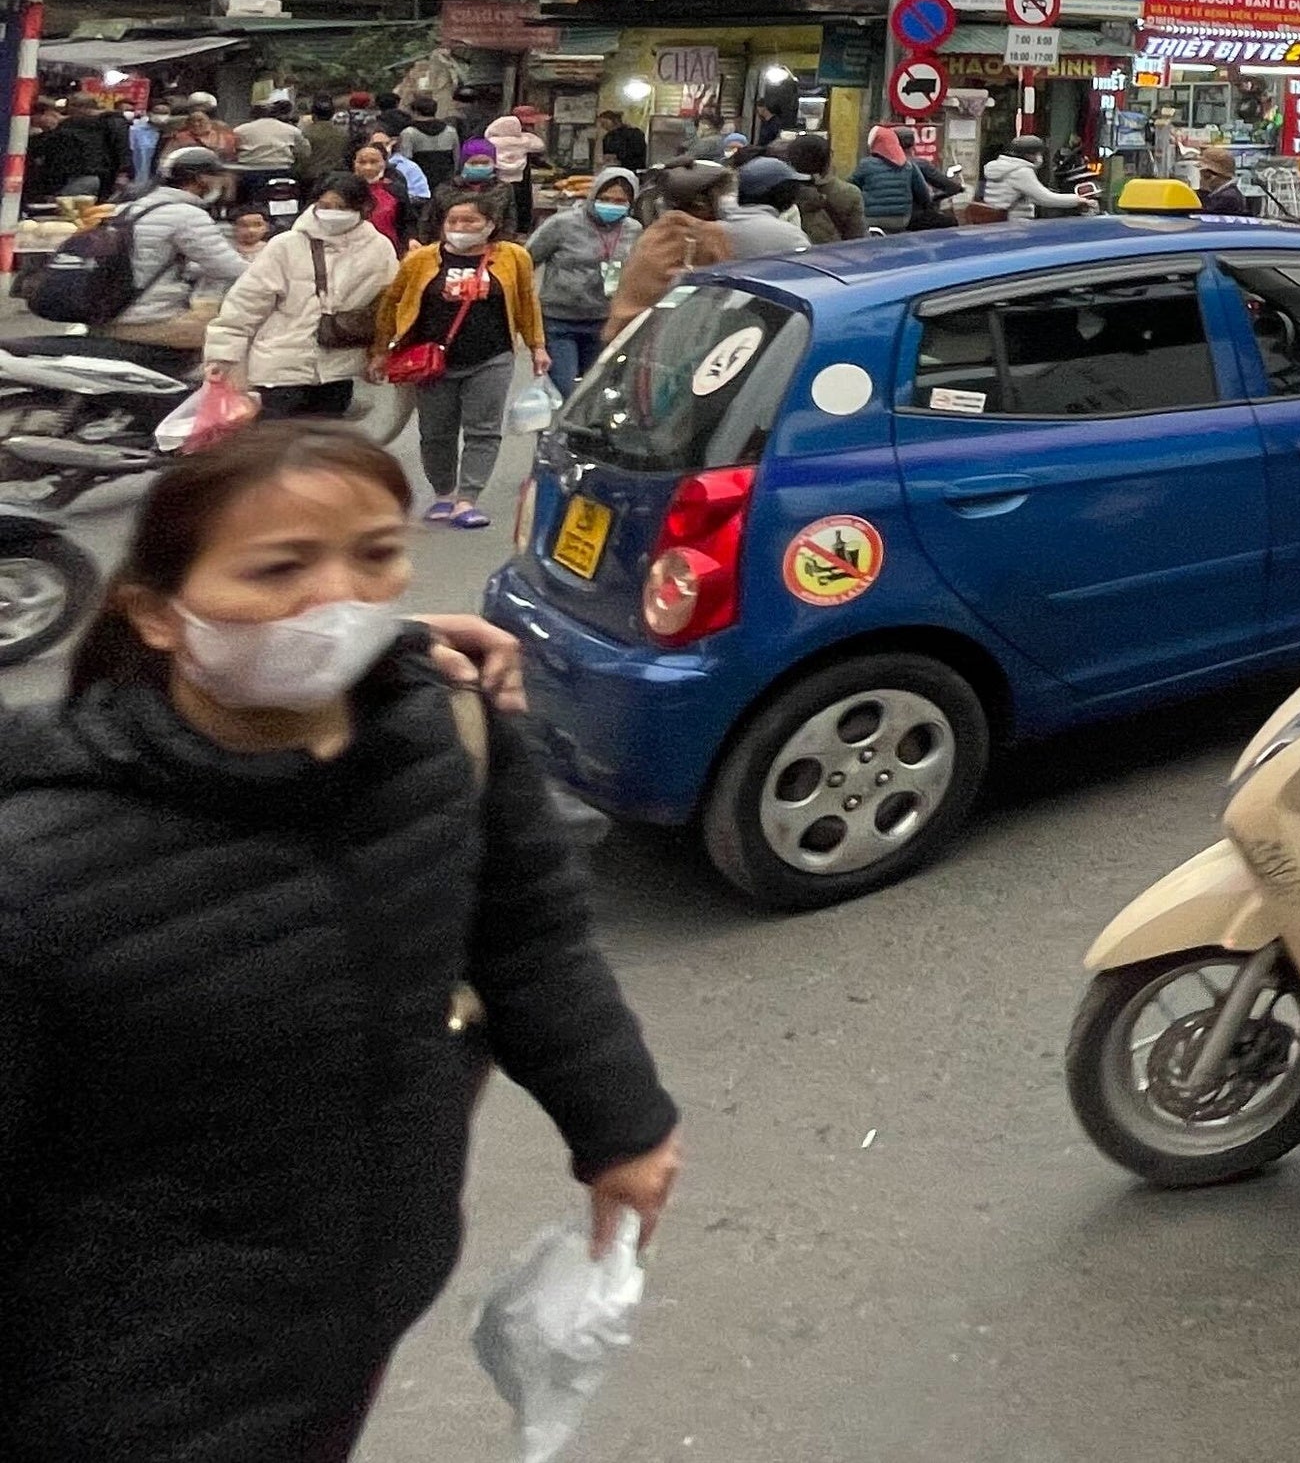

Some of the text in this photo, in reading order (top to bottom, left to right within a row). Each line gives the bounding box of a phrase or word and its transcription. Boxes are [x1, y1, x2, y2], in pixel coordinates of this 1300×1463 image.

[1145, 35, 1213, 60] THIẾT
[1214, 41, 1242, 63] BỊ
[1243, 43, 1260, 59] Y
